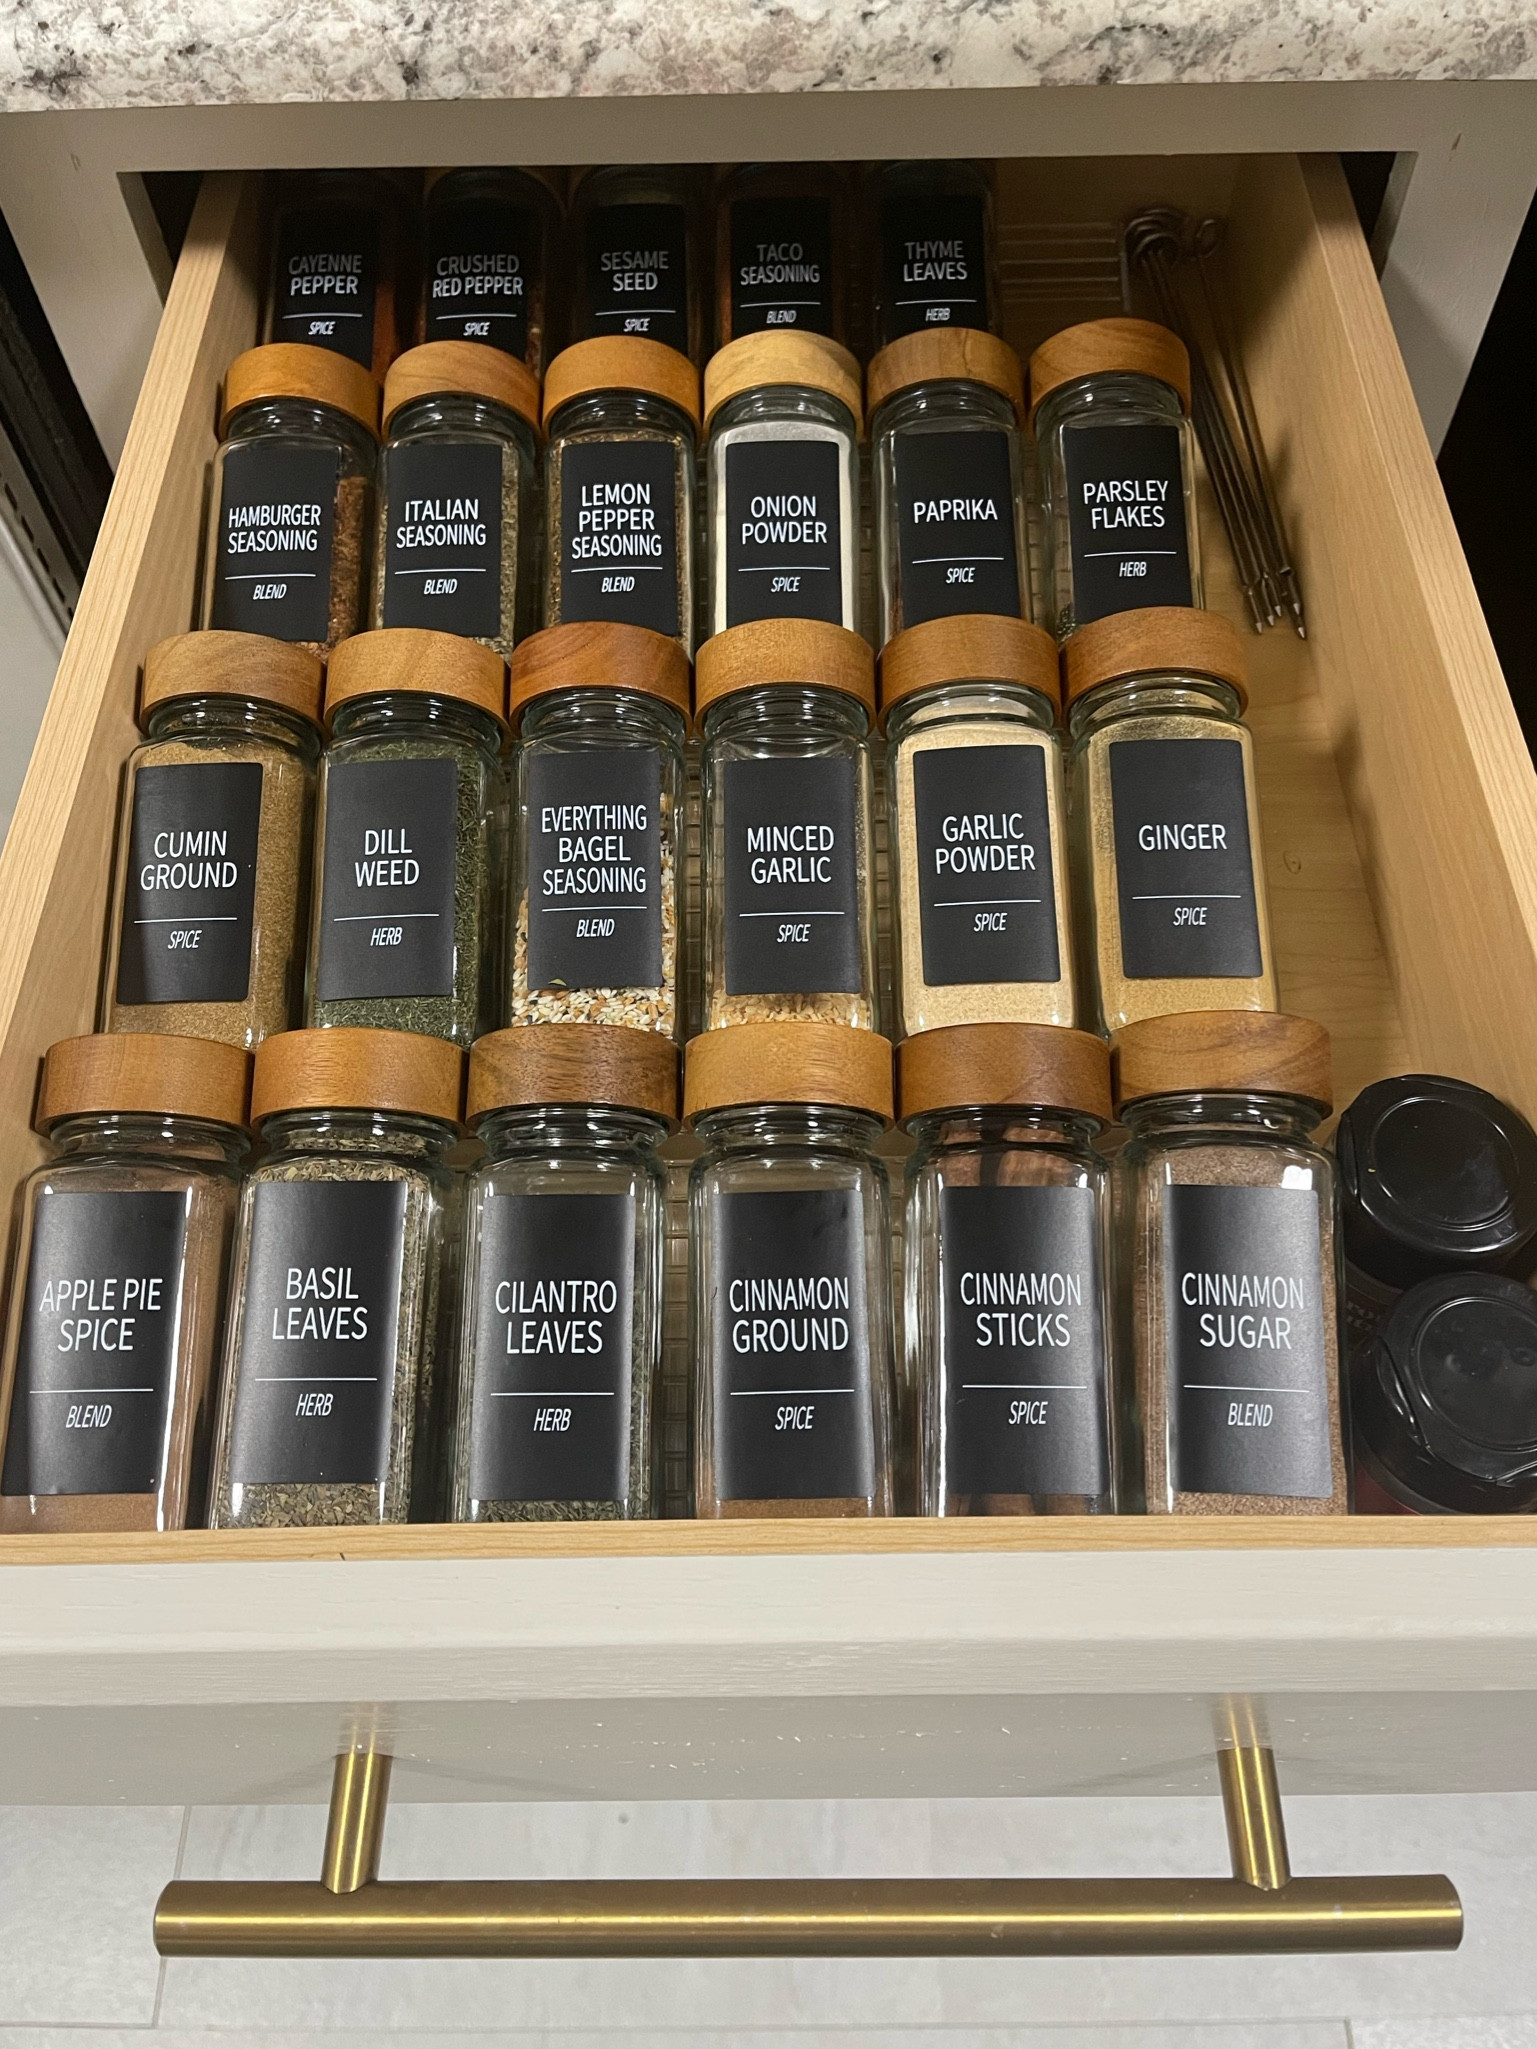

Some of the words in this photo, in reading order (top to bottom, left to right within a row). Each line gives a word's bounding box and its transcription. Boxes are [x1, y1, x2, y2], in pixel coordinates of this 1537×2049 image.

[601, 251, 669, 271] SESAME
[757, 243, 803, 262] TACO
[905, 241, 964, 260] THYME
[289, 254, 361, 274] CAYENNE
[437, 255, 519, 275] CRUSHED
[741, 265, 820, 285] SEASONING
[904, 262, 967, 282] LEAVES
[291, 276, 358, 296] PEPPER
[433, 278, 461, 298] RED
[465, 276, 522, 295] PEPPER
[613, 273, 657, 291] SEED
[624, 318, 650, 332] SPICE
[766, 311, 796, 323] BLEND
[926, 308, 950, 321] HERB
[308, 321, 335, 335] SPICE
[464, 322, 490, 336] SPICE
[582, 484, 650, 506] LEMON
[1084, 480, 1168, 504] PARSLEY
[229, 504, 321, 528] HAMBURGER
[406, 499, 478, 522] ITALIAN
[751, 496, 816, 518] ONION
[914, 499, 997, 523] PAPRIKA
[1092, 506, 1165, 529] FLAKES
[579, 509, 654, 532] PEPPER
[228, 530, 317, 553] SEASONING
[397, 524, 486, 548] SEASONING
[742, 522, 827, 544] POWDER
[572, 534, 661, 559] SEASONING
[946, 568, 975, 583] SPICE
[1119, 562, 1146, 577] HERB
[253, 584, 286, 600] BLEND
[424, 579, 457, 594] BLEND
[602, 577, 635, 592] BLEND
[771, 577, 800, 592] SPICE
[542, 805, 646, 832] EVERYTHING
[943, 813, 1024, 842] GARLIC
[155, 831, 226, 858] CUMIN
[365, 829, 412, 855] DILL
[748, 826, 834, 852] MINCED
[1139, 824, 1227, 850] GINGER
[559, 836, 631, 862] BAGEL
[936, 845, 1035, 874] POWDER
[141, 862, 237, 890] GROUND
[355, 860, 419, 887] WEED
[543, 867, 646, 895] SEASONING
[751, 857, 831, 884] GARLIC
[974, 913, 1007, 931] SPICE
[1173, 907, 1207, 925] SPICE
[168, 930, 202, 949] SPICE
[370, 927, 402, 946] HERB
[577, 919, 614, 937] BLEND
[777, 924, 811, 942] SPICE
[287, 1267, 358, 1299] BASIL
[730, 1277, 848, 1312] CINNAMON
[961, 1272, 1080, 1305] CINNAMON
[1181, 1273, 1305, 1310] CINNAMON
[40, 1279, 117, 1311] APPLE
[123, 1279, 162, 1310] PIE
[496, 1280, 616, 1313] CILANTRO
[58, 1318, 135, 1351] SPICE
[273, 1307, 367, 1339] LEAVES
[977, 1313, 1069, 1346] STICKS
[1200, 1314, 1291, 1348] SUGAR
[507, 1321, 602, 1353] LEAVES
[733, 1318, 848, 1353] GROUND
[66, 1405, 112, 1428] BLEND
[296, 1394, 333, 1416] HERB
[1009, 1401, 1048, 1424] SPICE
[1228, 1403, 1272, 1426] BLEND
[534, 1409, 571, 1431] HERB
[775, 1406, 814, 1430] SPICE
